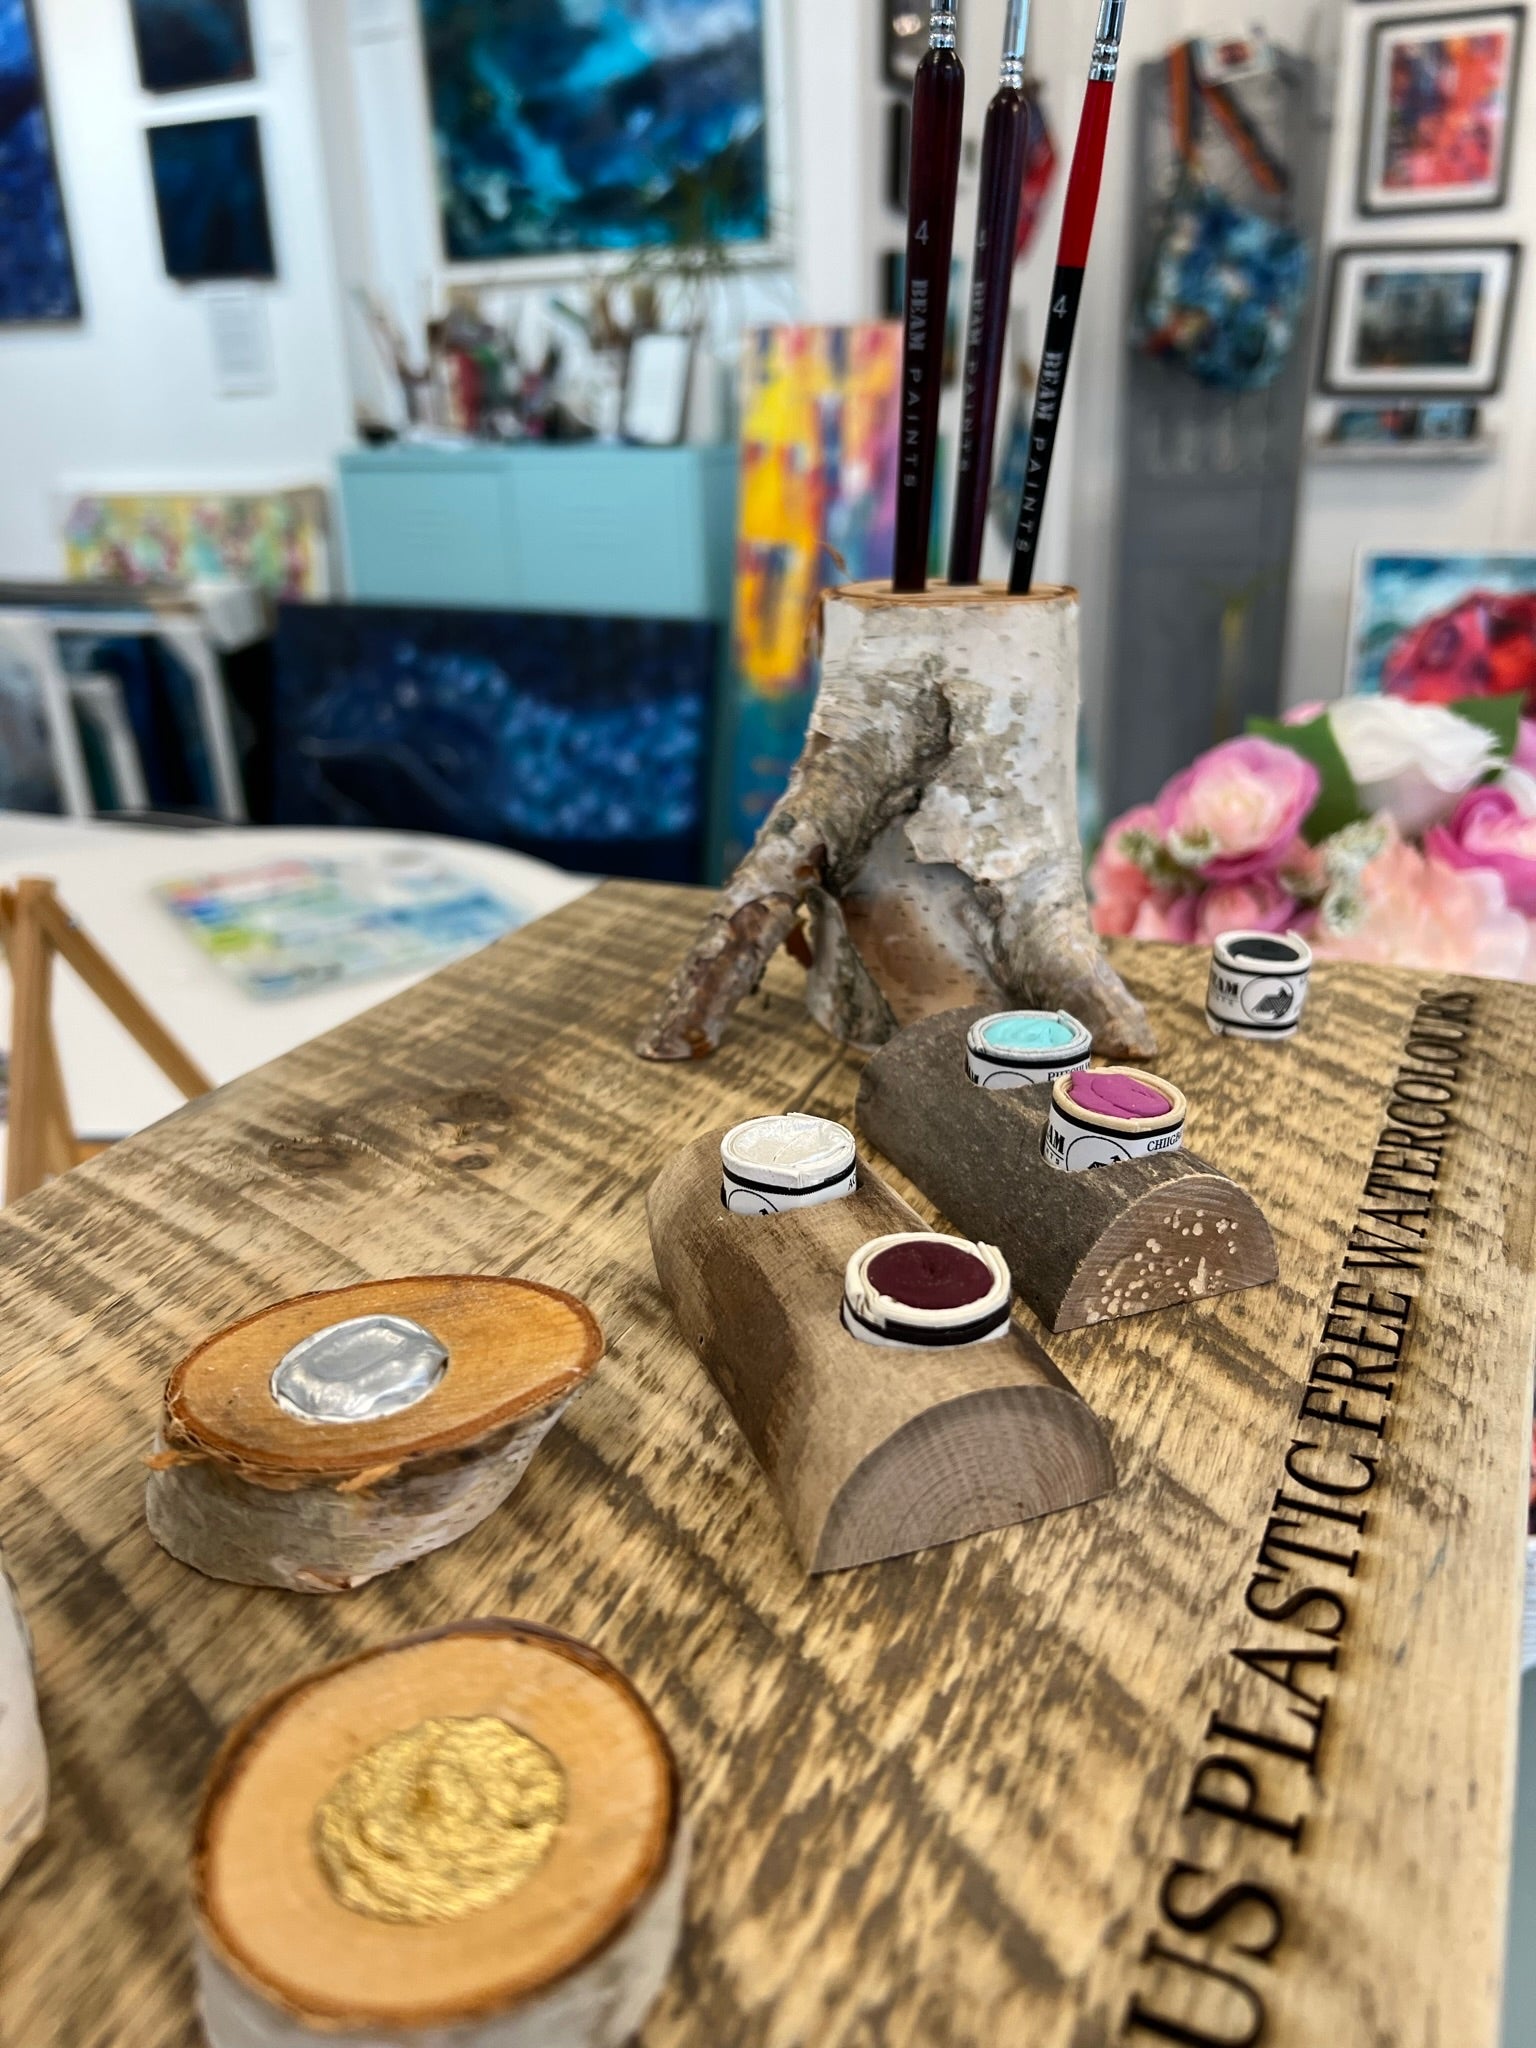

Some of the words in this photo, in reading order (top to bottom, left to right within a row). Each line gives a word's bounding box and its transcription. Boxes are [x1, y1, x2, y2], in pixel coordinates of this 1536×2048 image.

[914, 219, 929, 246] 4
[908, 280, 928, 350] BEAM
[1052, 294, 1068, 319] 4
[904, 367, 922, 487] PAINTS
[1036, 352, 1064, 421] BEAM
[1016, 437, 1046, 553] PAINTS
[1341, 988, 1475, 1272] WATERCOLOURS
[1297, 1280, 1413, 1439] FREE
[1181, 1439, 1379, 1856] PLASTIC
